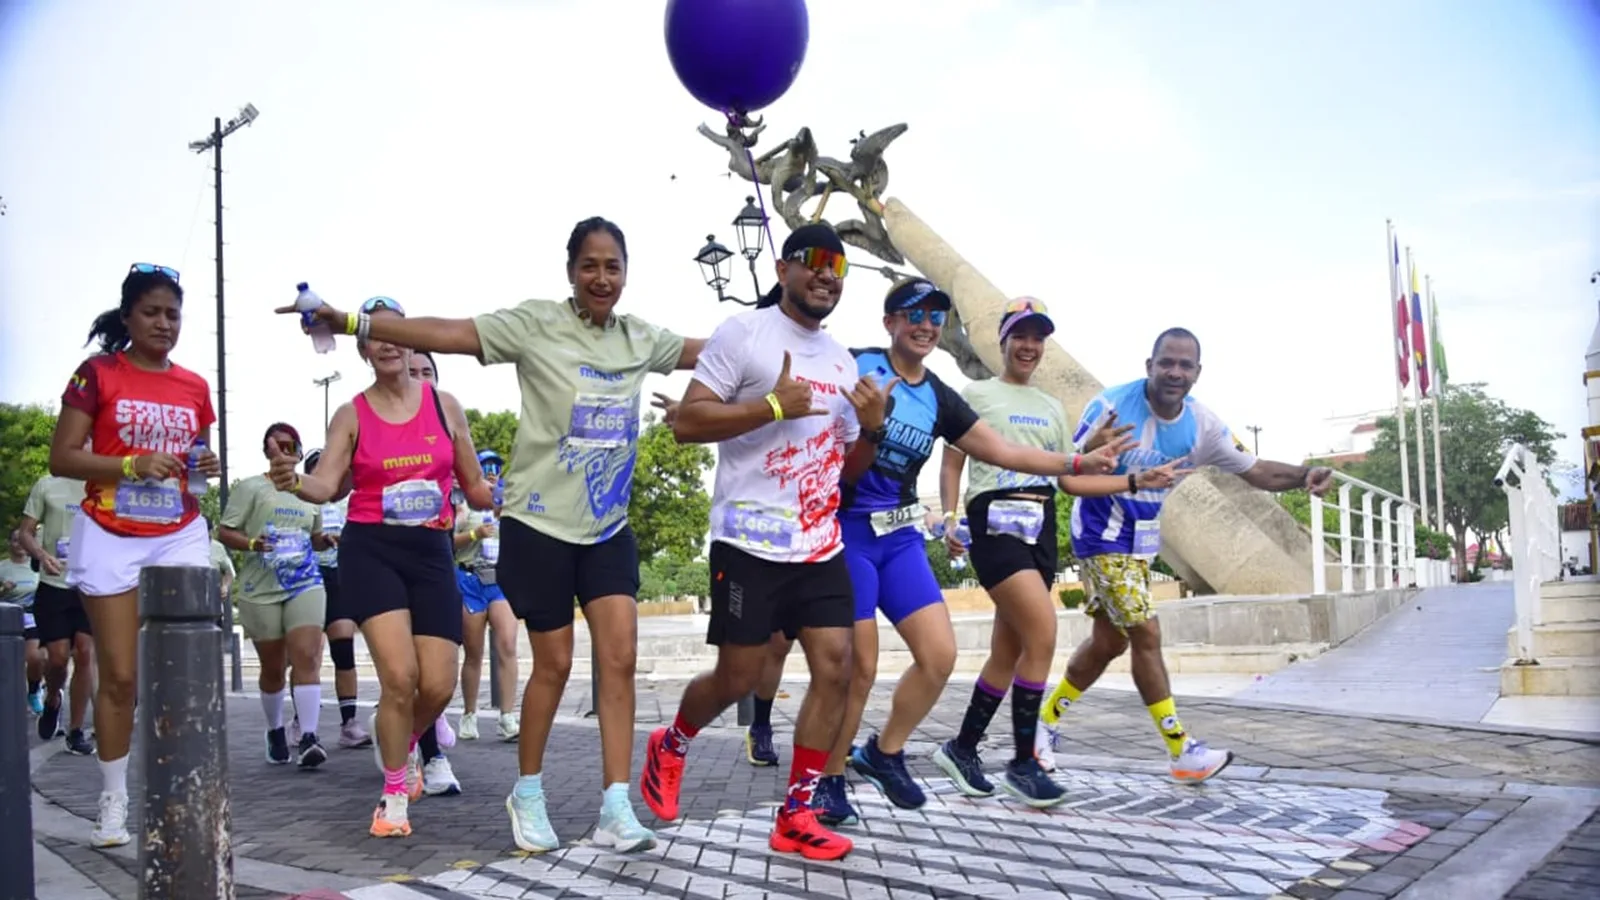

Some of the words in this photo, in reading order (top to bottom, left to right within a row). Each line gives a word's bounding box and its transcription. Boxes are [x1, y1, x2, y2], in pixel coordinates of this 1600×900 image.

[584, 412, 625, 430] 1666
[383, 454, 432, 470] mmvu
[127, 491, 175, 508] 1635
[393, 496, 434, 512] 1665
[886, 508, 914, 525] 301
